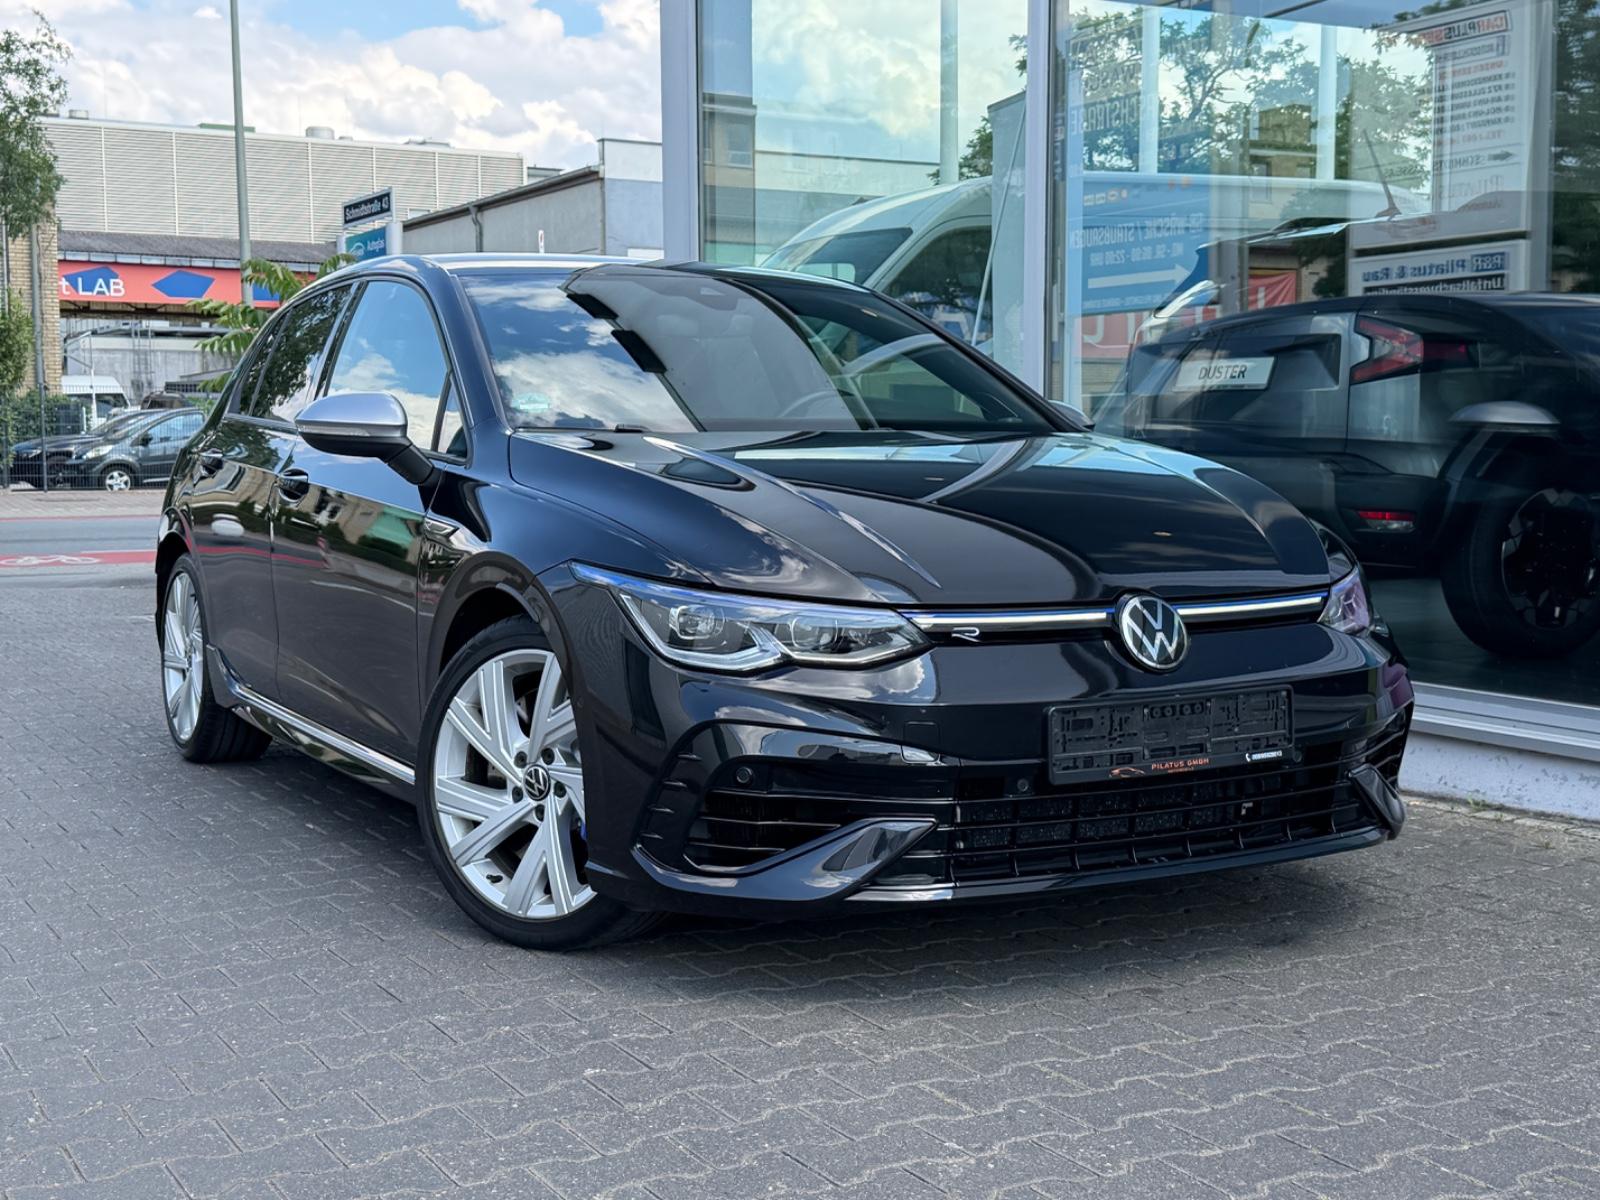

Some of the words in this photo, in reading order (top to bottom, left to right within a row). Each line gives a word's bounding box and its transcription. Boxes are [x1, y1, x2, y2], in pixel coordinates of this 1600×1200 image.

[77, 276, 126, 297] LAB
[1198, 364, 1248, 381] DUSTER
[1151, 760, 1185, 771] PILATUS
